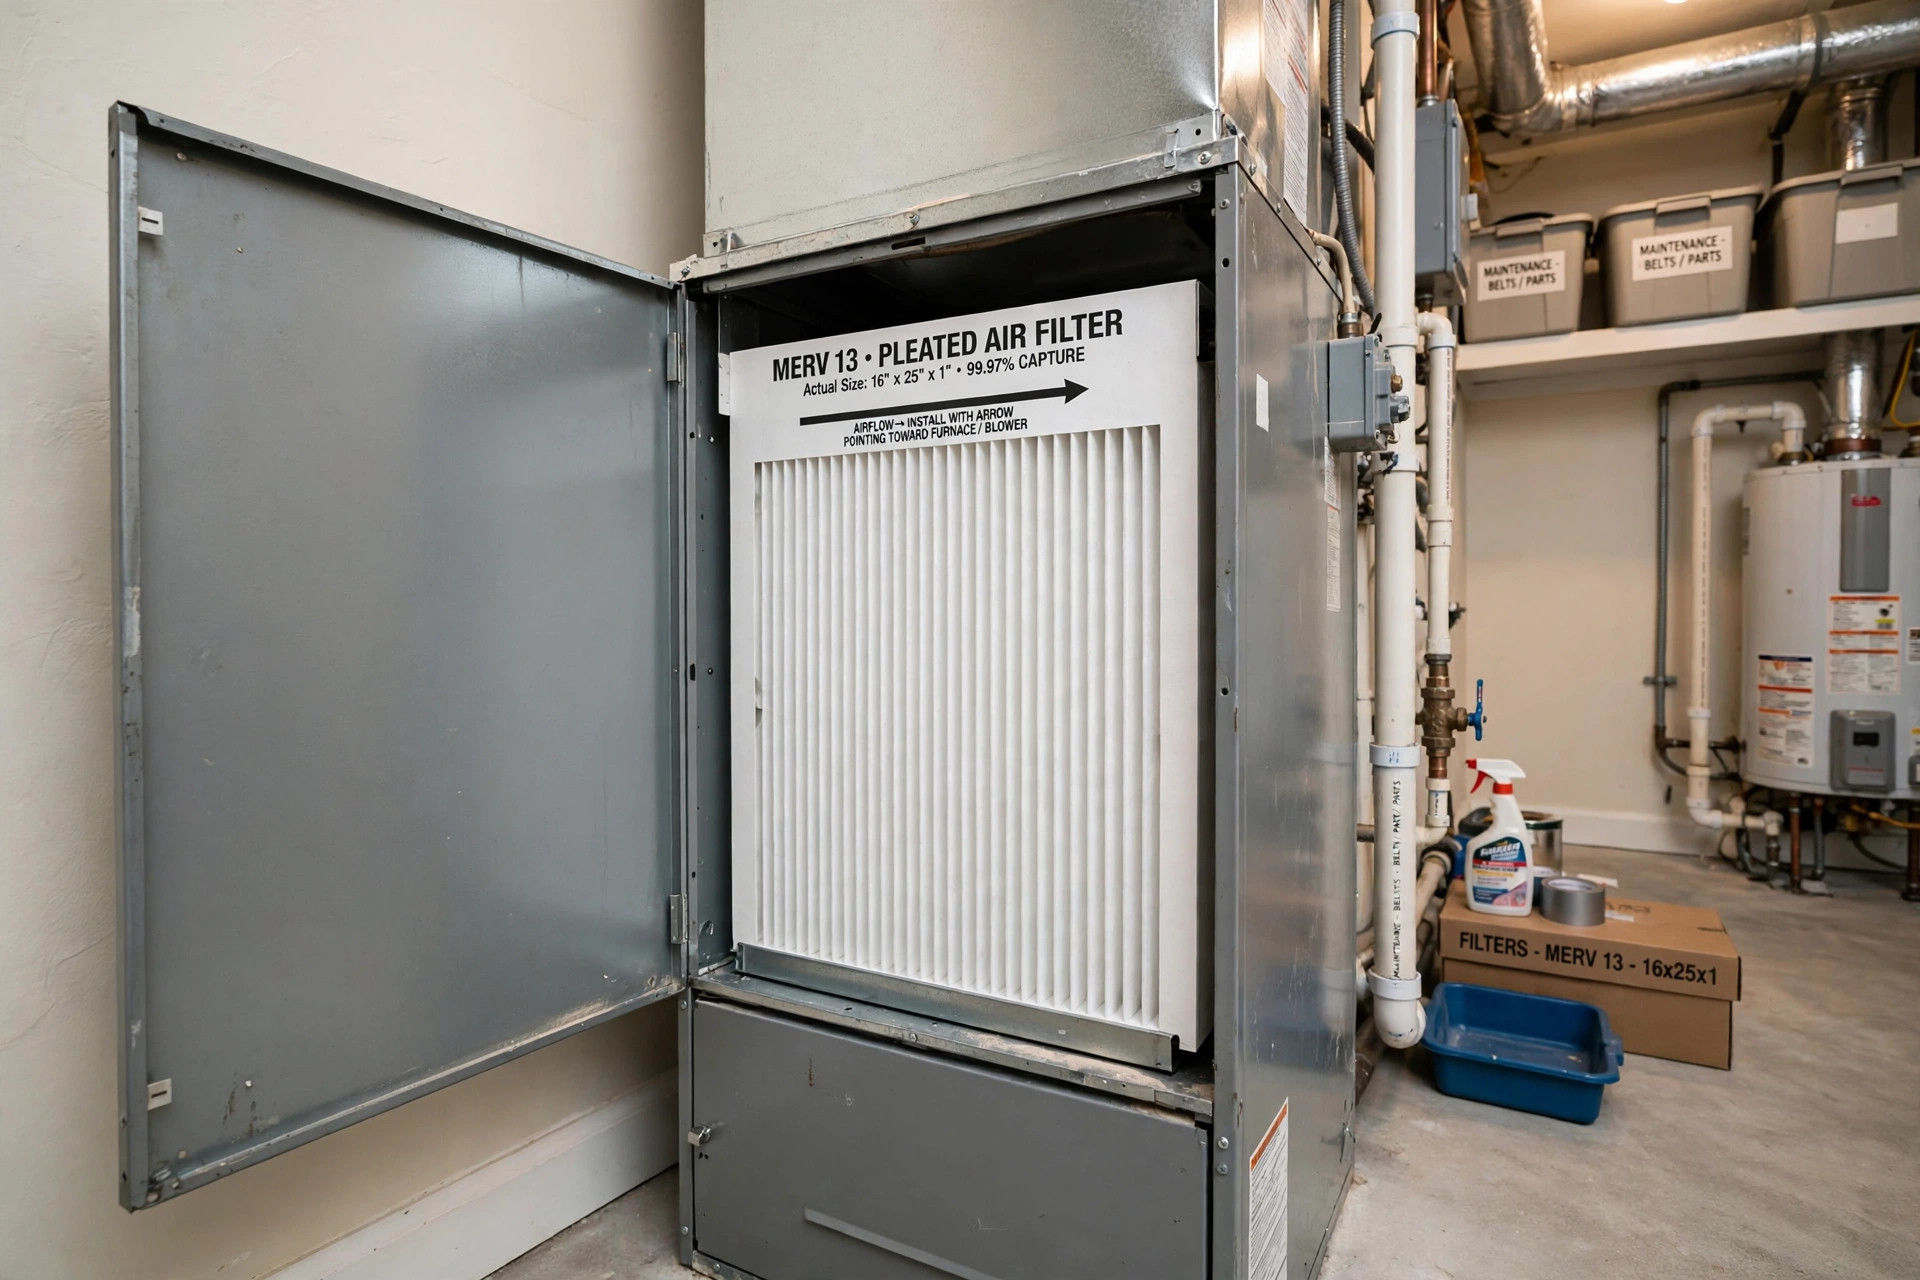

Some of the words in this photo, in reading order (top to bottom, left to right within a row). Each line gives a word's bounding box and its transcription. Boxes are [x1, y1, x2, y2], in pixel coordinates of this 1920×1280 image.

[1640, 234, 1718, 256] MAINTENANCE
[1484, 258, 1552, 277] MAINTENANCE
[1644, 256, 1676, 270] BELTS
[1688, 250, 1722, 265] PARTS
[1488, 278, 1517, 291] BELTS
[1526, 273, 1556, 287] PARTS
[773, 352, 830, 382] MERV
[835, 348, 858, 374] 13
[879, 330, 977, 368] PLEATED
[984, 323, 1026, 353] AIR
[1035, 309, 1123, 346] FILTER
[803, 379, 837, 397] Actual
[841, 377, 867, 391] Size:
[871, 373, 890, 388] 16"
[893, 374, 901, 385] x
[904, 368, 924, 384] 25"
[928, 370, 935, 381] x
[939, 364, 951, 380] 1"
[967, 356, 1015, 376] 99.97%
[1019, 346, 1085, 369] CAPTURE
[907, 413, 946, 428] INSTALL
[949, 411, 974, 424] WITH
[976, 406, 1014, 421] ARROW
[843, 432, 886, 447] POINTING
[888, 428, 929, 444] TOWARD
[984, 418, 1028, 434] BLOWER
[1459, 931, 1528, 958] FILTERS
[1545, 943, 1598, 968] MERV
[1603, 952, 1624, 972] 13
[1642, 958, 1717, 986] 16x25x1
